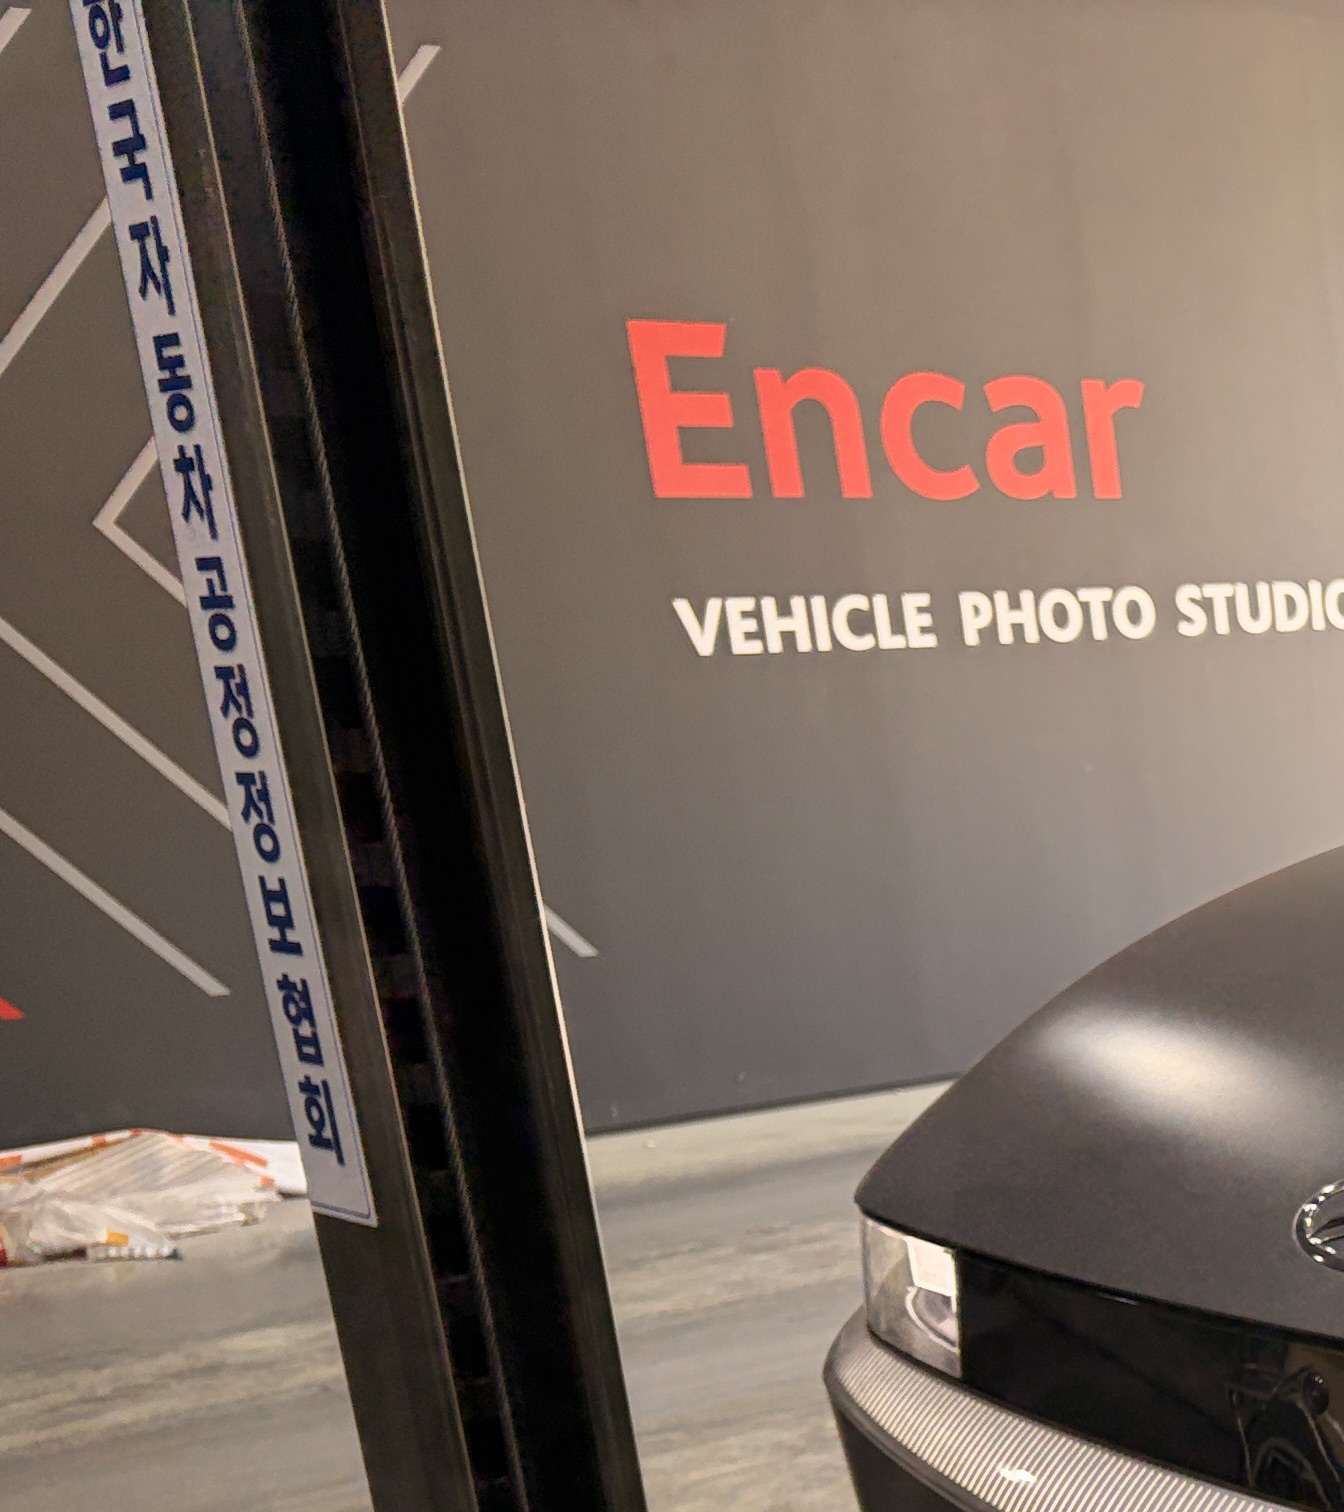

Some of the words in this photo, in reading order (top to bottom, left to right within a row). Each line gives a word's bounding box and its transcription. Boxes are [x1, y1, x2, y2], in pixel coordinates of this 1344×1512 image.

[625, 318, 1145, 501] Encar
[82, 0, 346, 1166] 한국자동차공정정보협회
[672, 593, 937, 657] VEHICLE
[960, 585, 1155, 646] PHOTO
